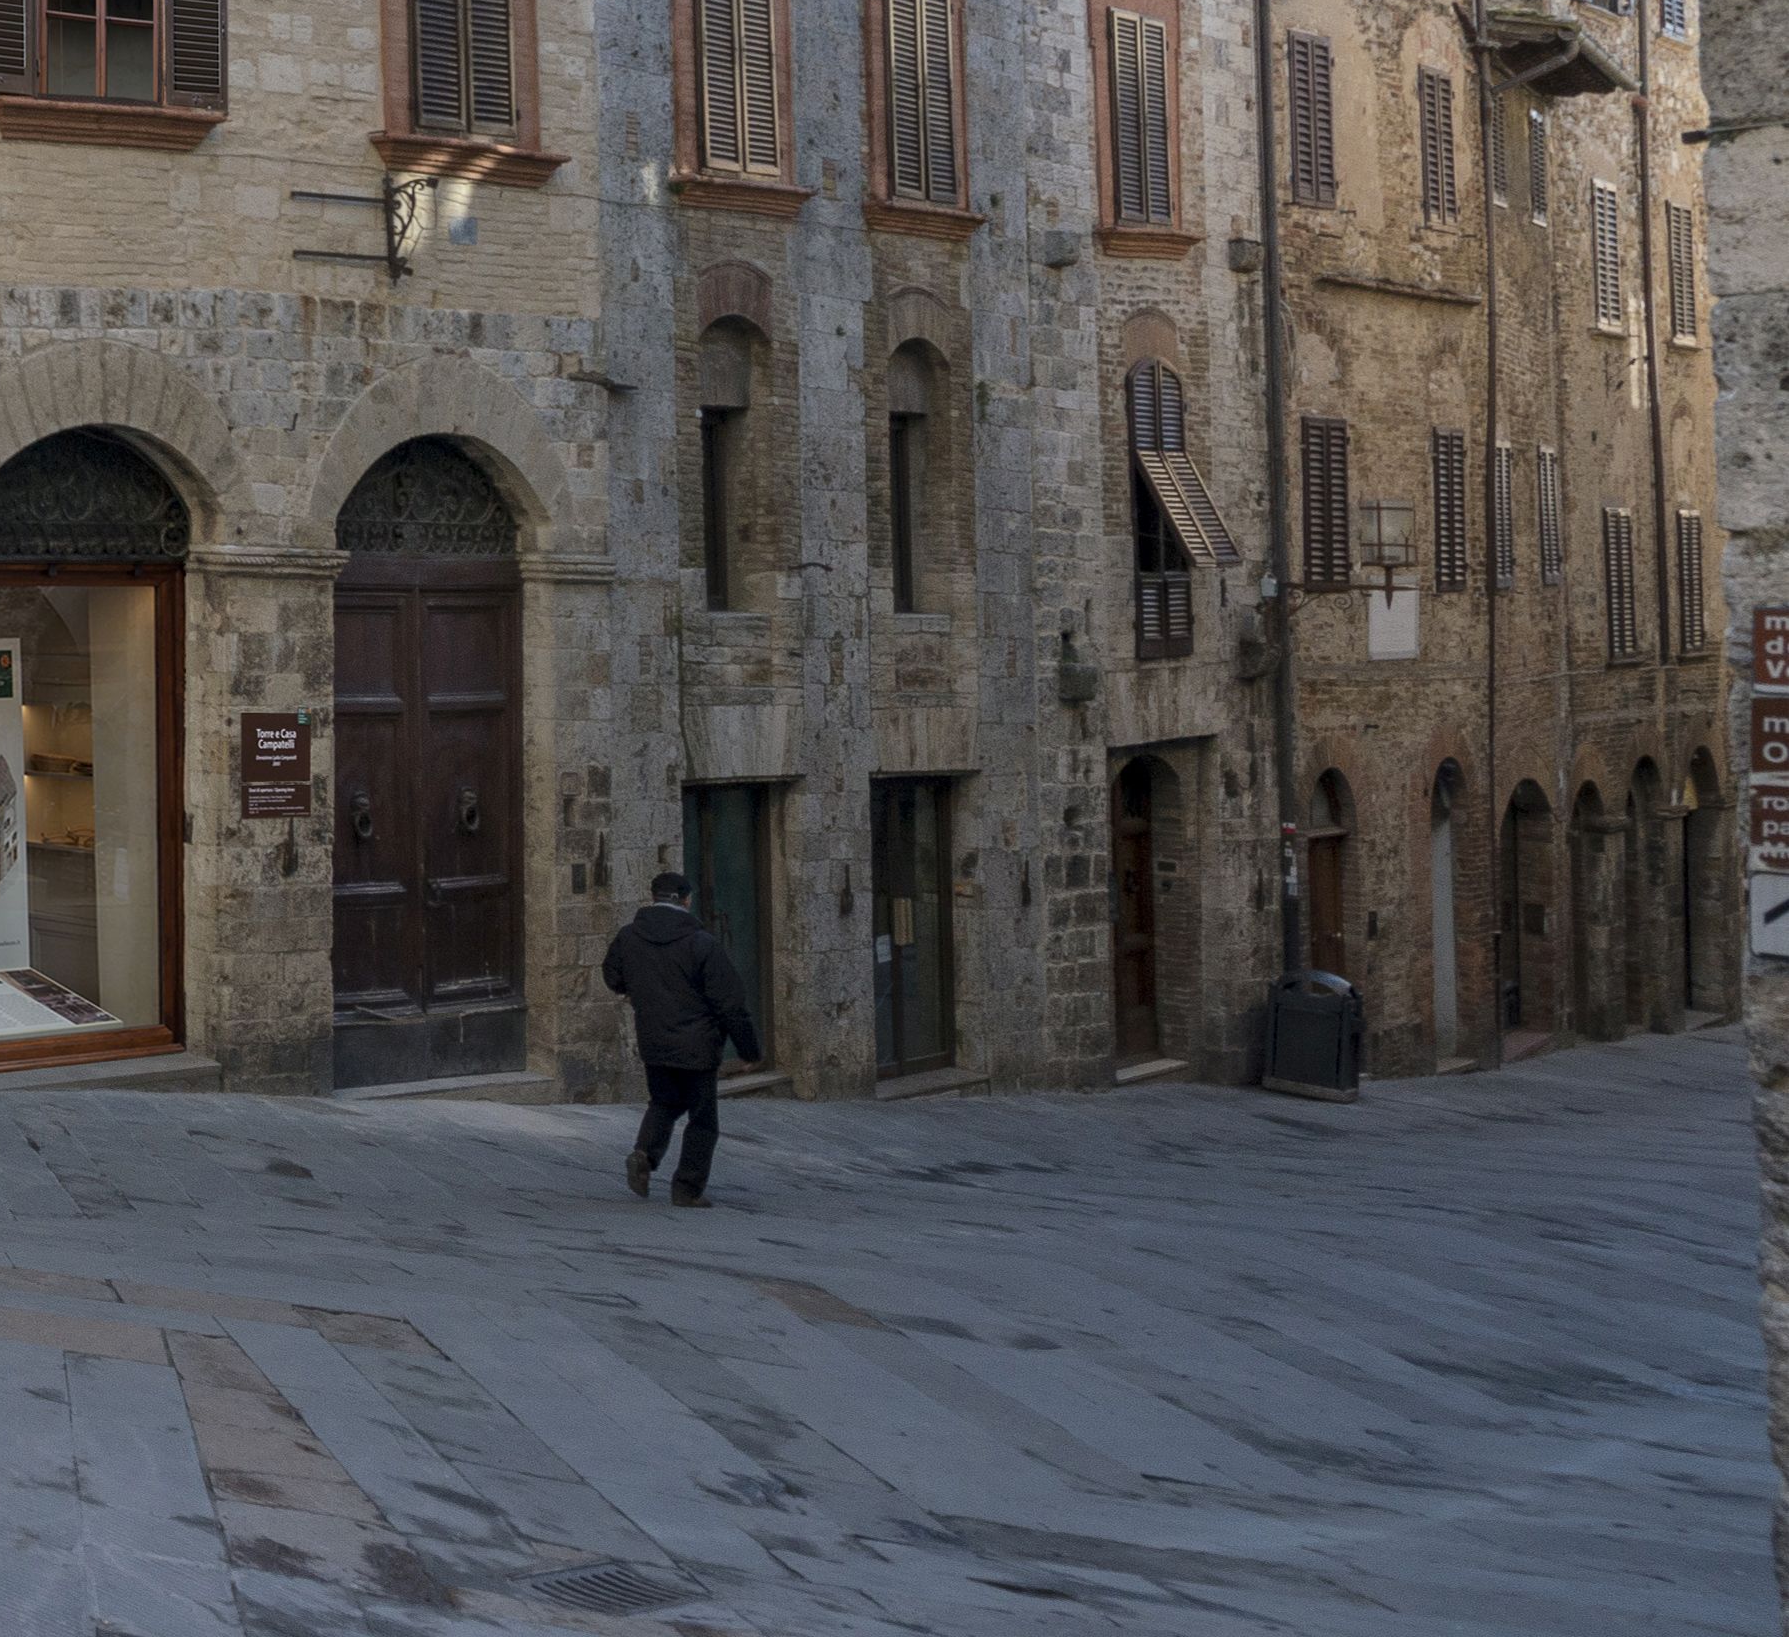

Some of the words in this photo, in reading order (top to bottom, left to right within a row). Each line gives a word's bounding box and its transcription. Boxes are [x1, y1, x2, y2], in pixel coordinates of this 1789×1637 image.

[1764, 636, 1789, 655] d
[1765, 659, 1789, 679] V
[256, 728, 274, 739] Torre
[275, 731, 280, 739] e
[280, 728, 297, 739] Casa
[257, 739, 295, 751] Campatelli
